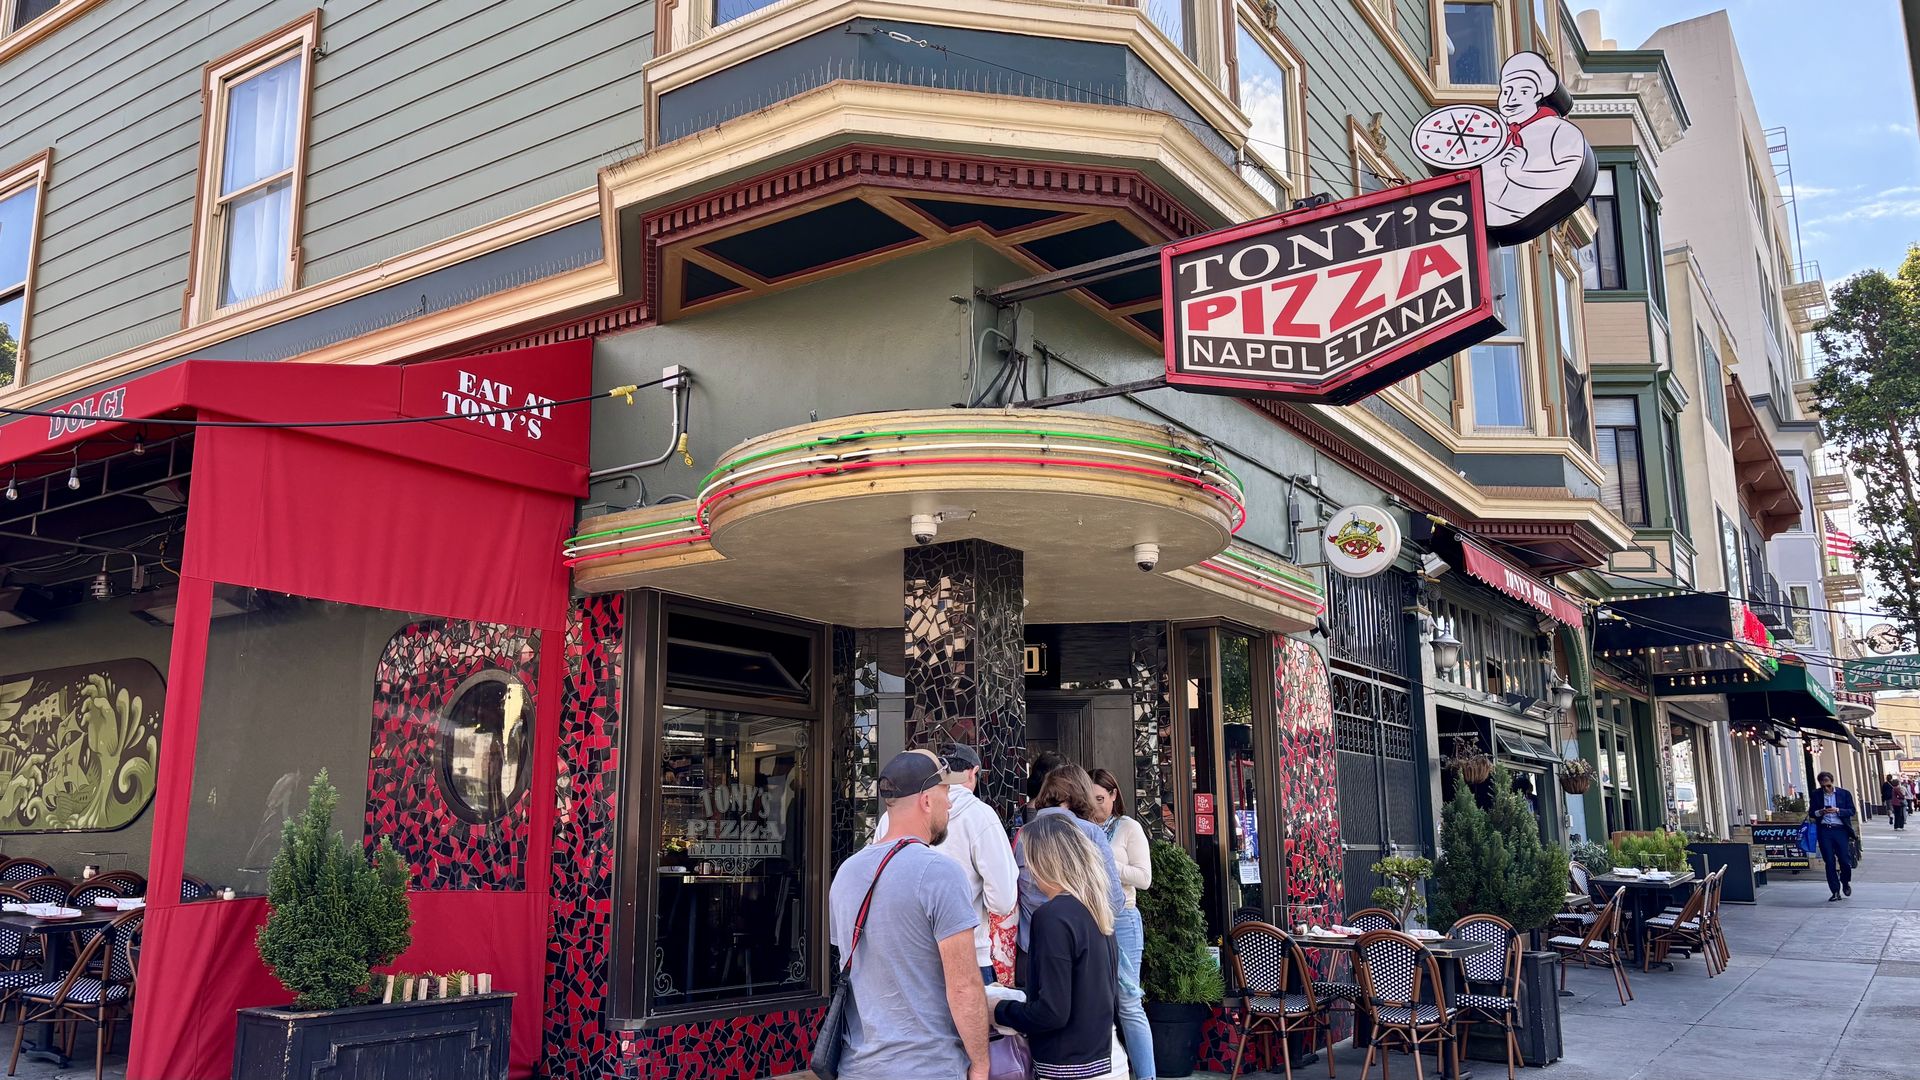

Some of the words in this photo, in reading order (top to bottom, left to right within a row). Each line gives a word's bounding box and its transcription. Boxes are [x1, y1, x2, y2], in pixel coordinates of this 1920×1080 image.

[1179, 195, 1469, 294] TONY'S
[1187, 244, 1463, 339] PIZZA
[1193, 287, 1456, 372] NAPOLETANA
[48, 386, 126, 440] DOLCI
[442, 391, 542, 440] TONY'S
[458, 370, 512, 406] EAT
[524, 393, 556, 420] AT
[1504, 569, 1531, 599] TONY'S
[1532, 584, 1552, 610] PIZZA
[699, 783, 771, 818] TONY'S
[686, 819, 786, 840] PIZZA
[690, 843, 778, 855] NAPOLETANA
